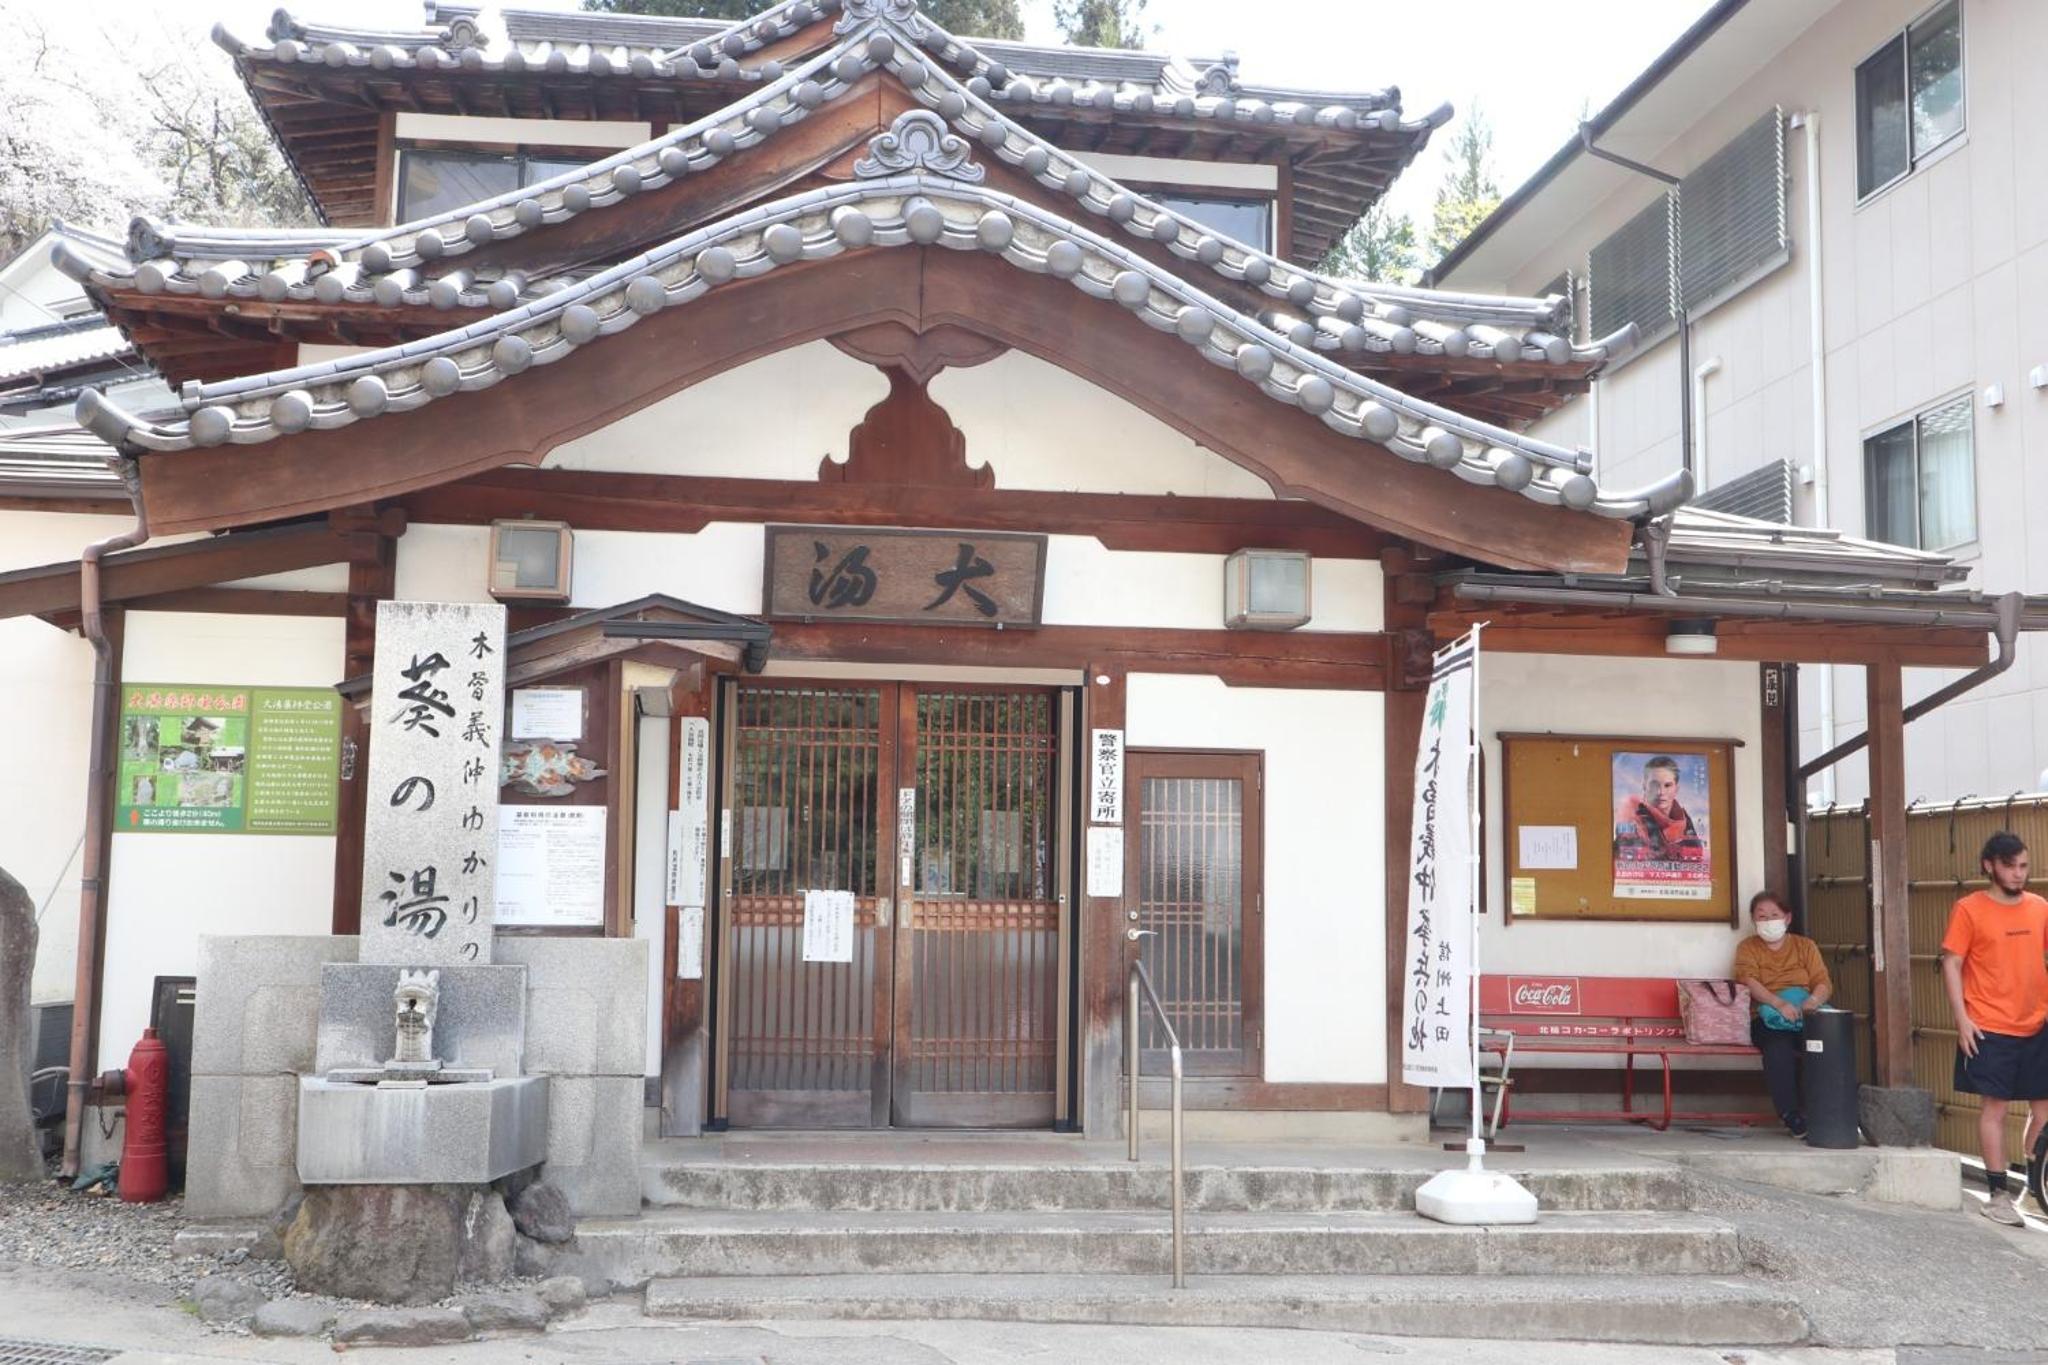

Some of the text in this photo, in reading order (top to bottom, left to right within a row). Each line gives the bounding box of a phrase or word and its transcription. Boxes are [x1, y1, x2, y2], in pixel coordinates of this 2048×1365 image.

[379, 652, 456, 940] 葵の湯
[1097, 733, 1118, 819] 警察官立寄所
[1515, 984, 1572, 1006] Coca-Cola
